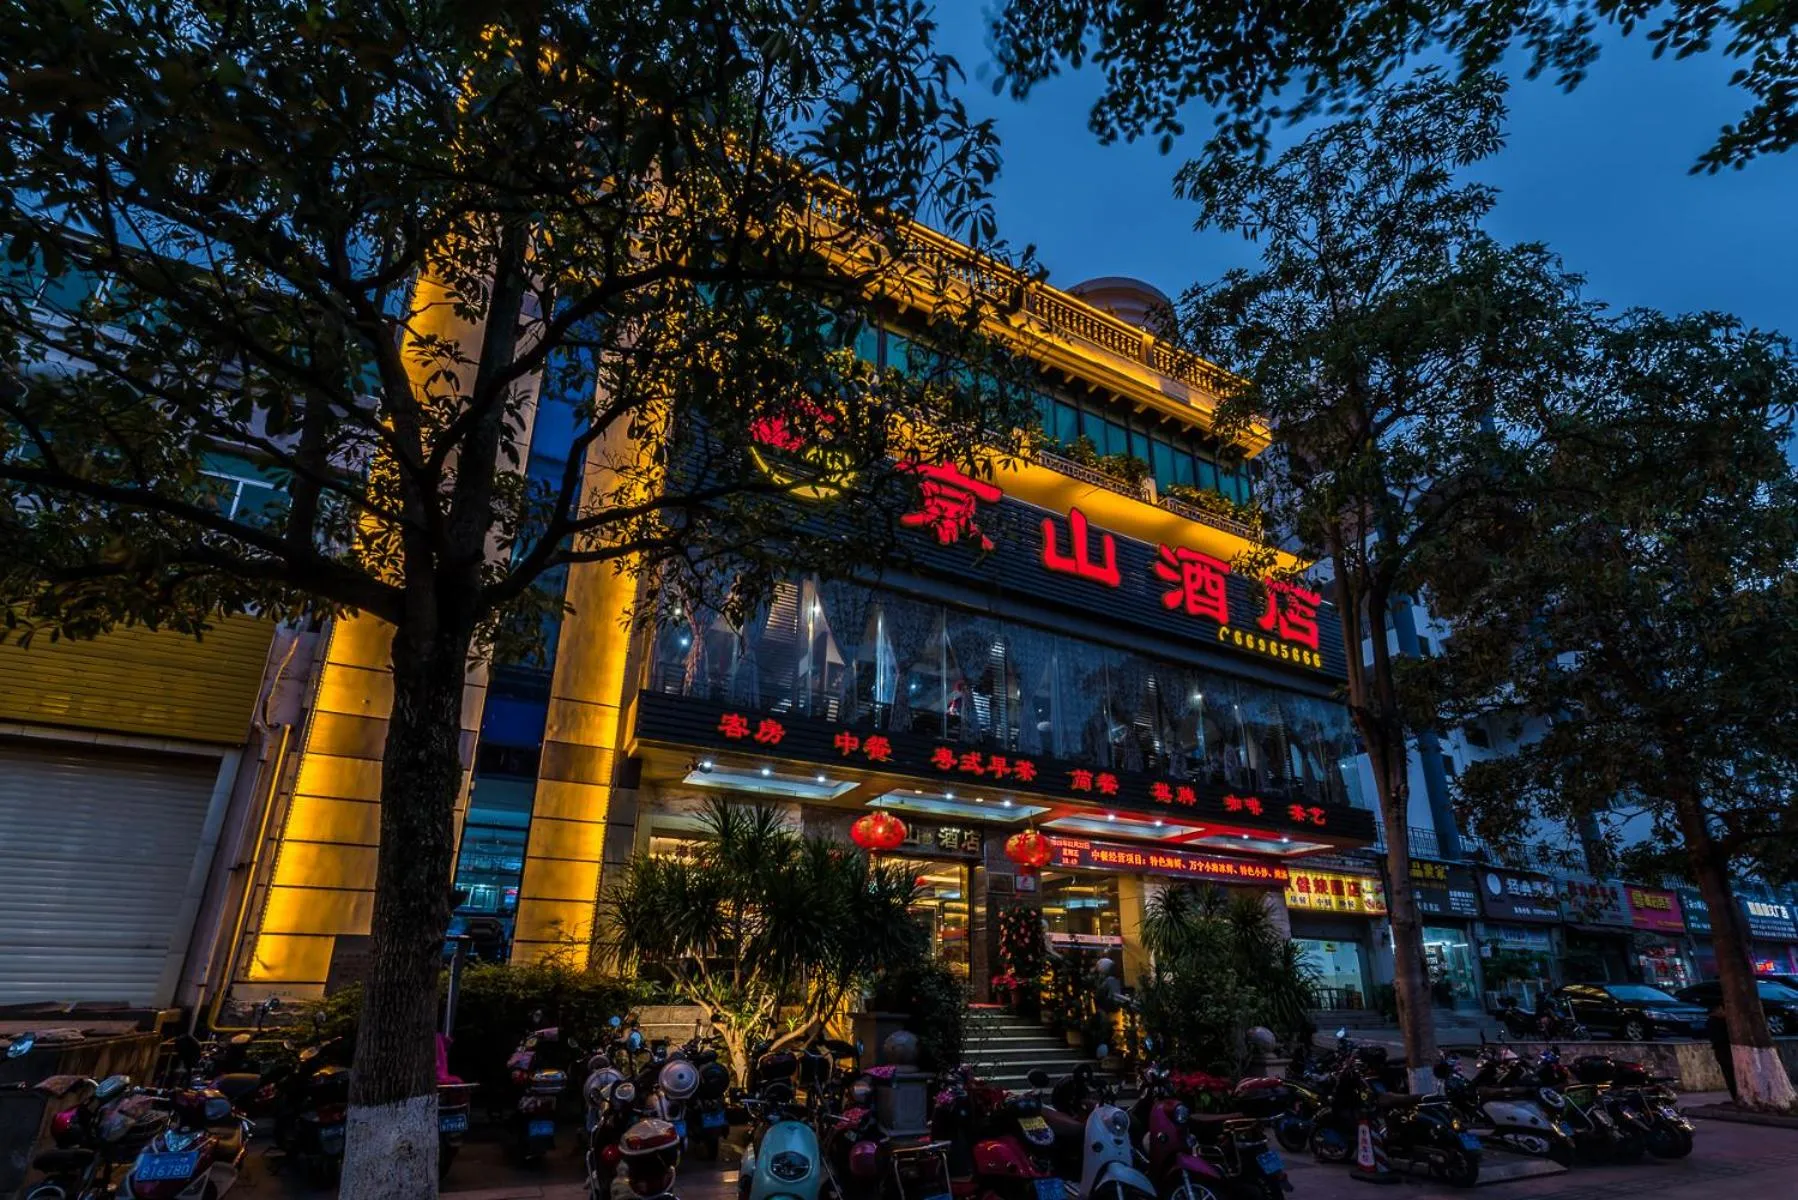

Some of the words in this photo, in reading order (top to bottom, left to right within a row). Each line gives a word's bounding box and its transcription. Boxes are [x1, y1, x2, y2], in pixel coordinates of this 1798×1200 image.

[1232, 629, 1322, 669] 66965666
[718, 712, 786, 745] 客房
[834, 732, 893, 762] 中餐
[930, 746, 1037, 782] 粤式早茶
[1152, 781, 1197, 806] 棋牌
[1224, 794, 1264, 817] 咖啡
[1288, 803, 1326, 827] 茶艺
[938, 826, 982, 853] 酒店
